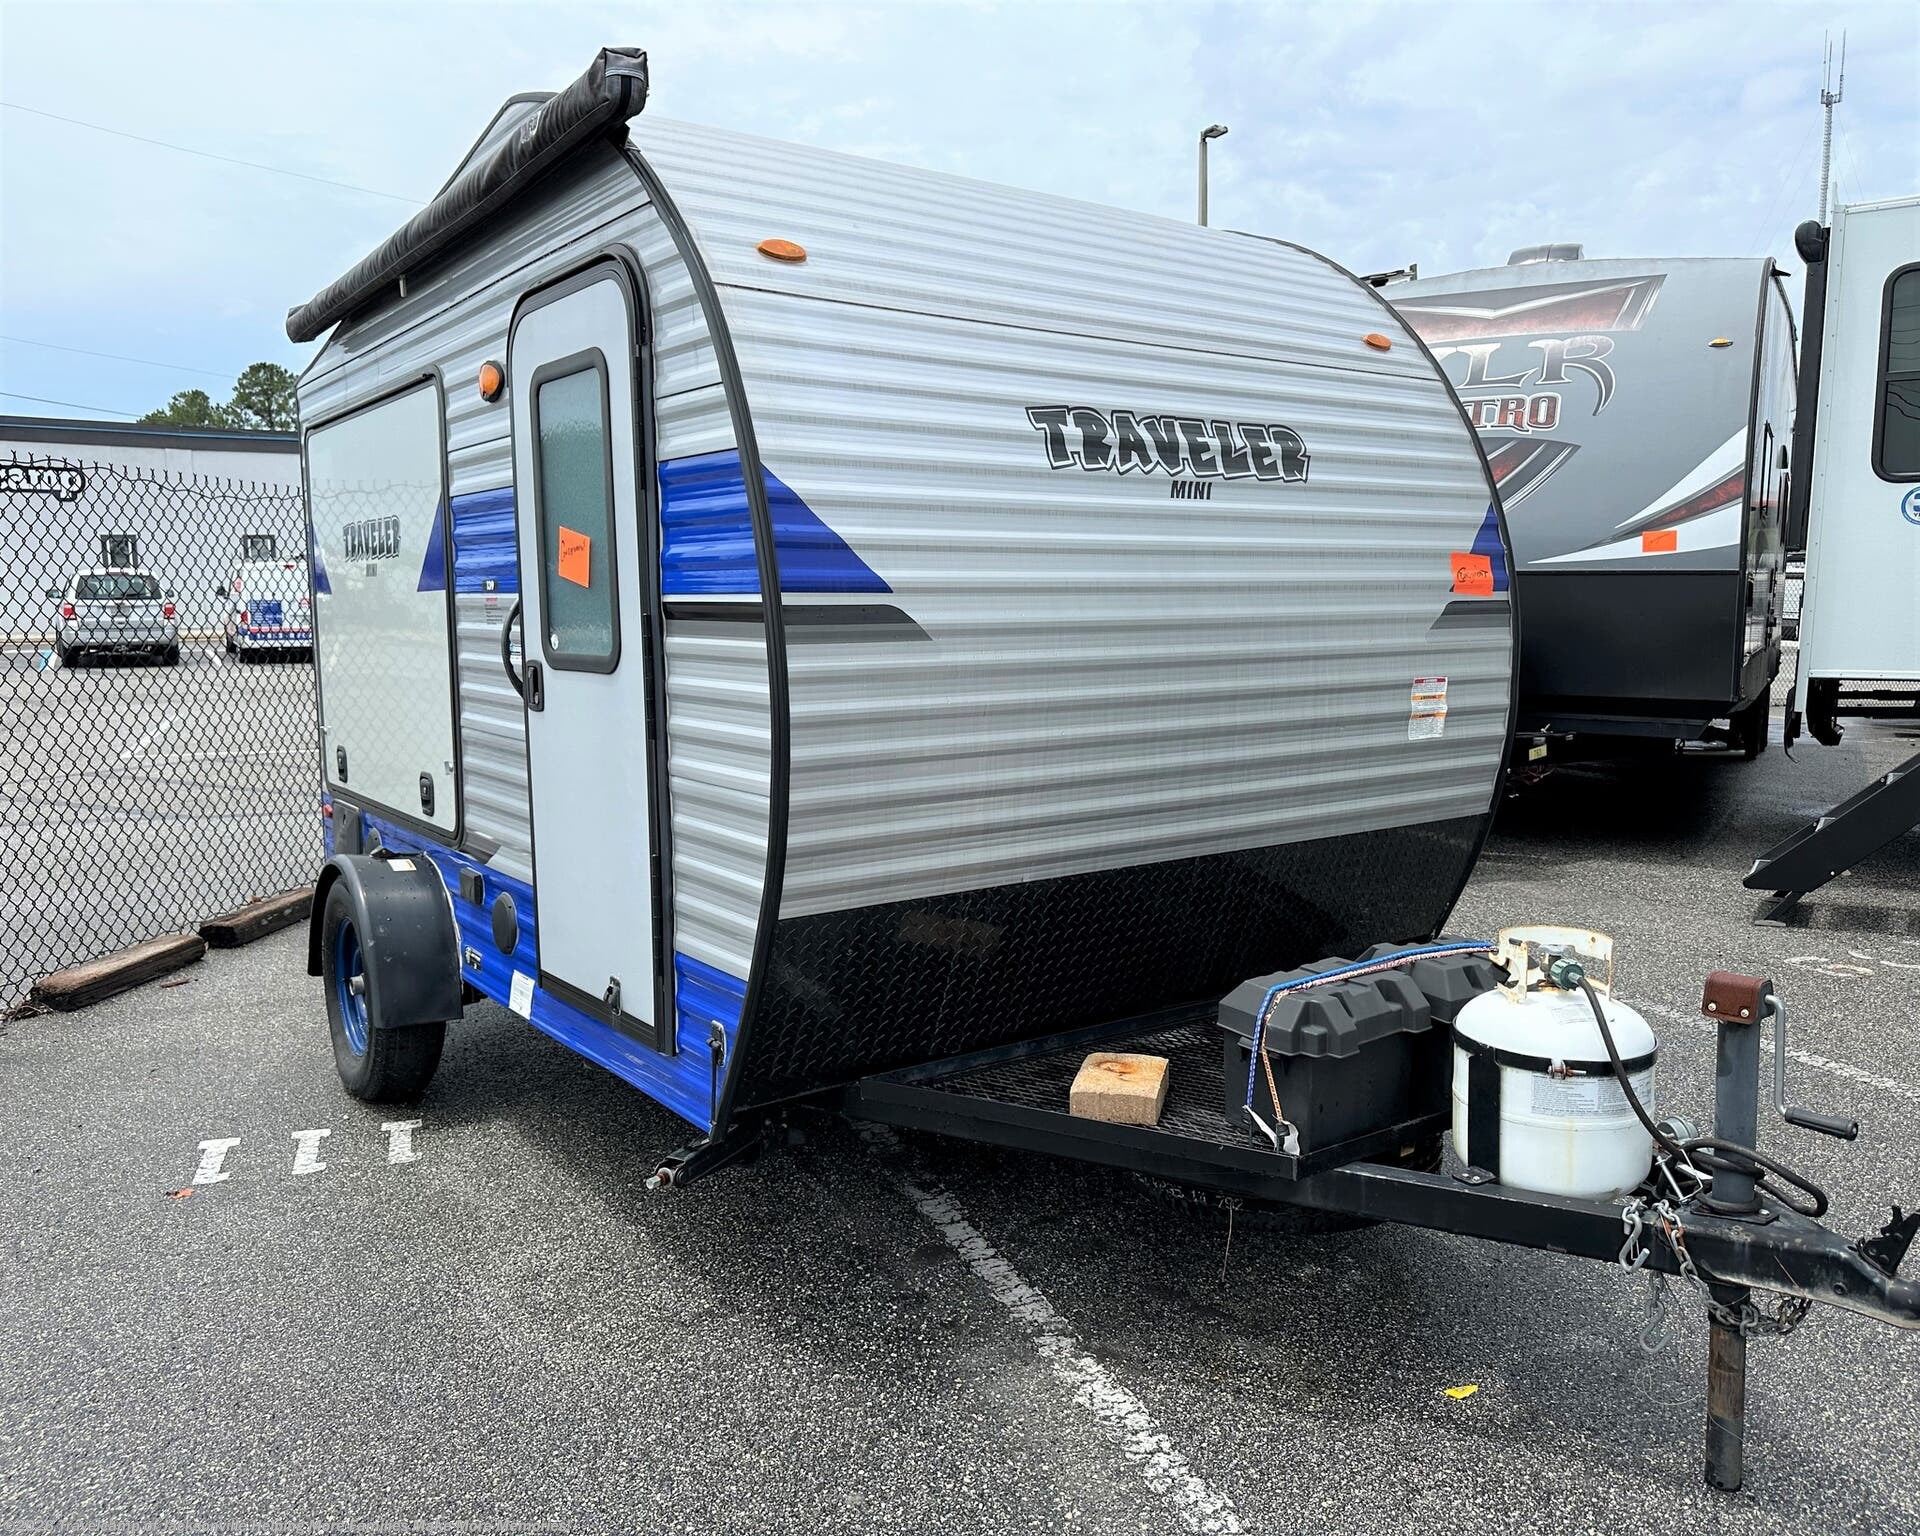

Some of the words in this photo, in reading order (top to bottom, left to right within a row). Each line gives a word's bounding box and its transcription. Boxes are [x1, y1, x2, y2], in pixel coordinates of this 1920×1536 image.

[1429, 335, 1616, 416] LR
[1461, 391, 1562, 435] TRO
[1025, 405, 1310, 483] TRAVELER
[1170, 480, 1213, 500] MINI
[343, 514, 401, 563] TRAVELER
